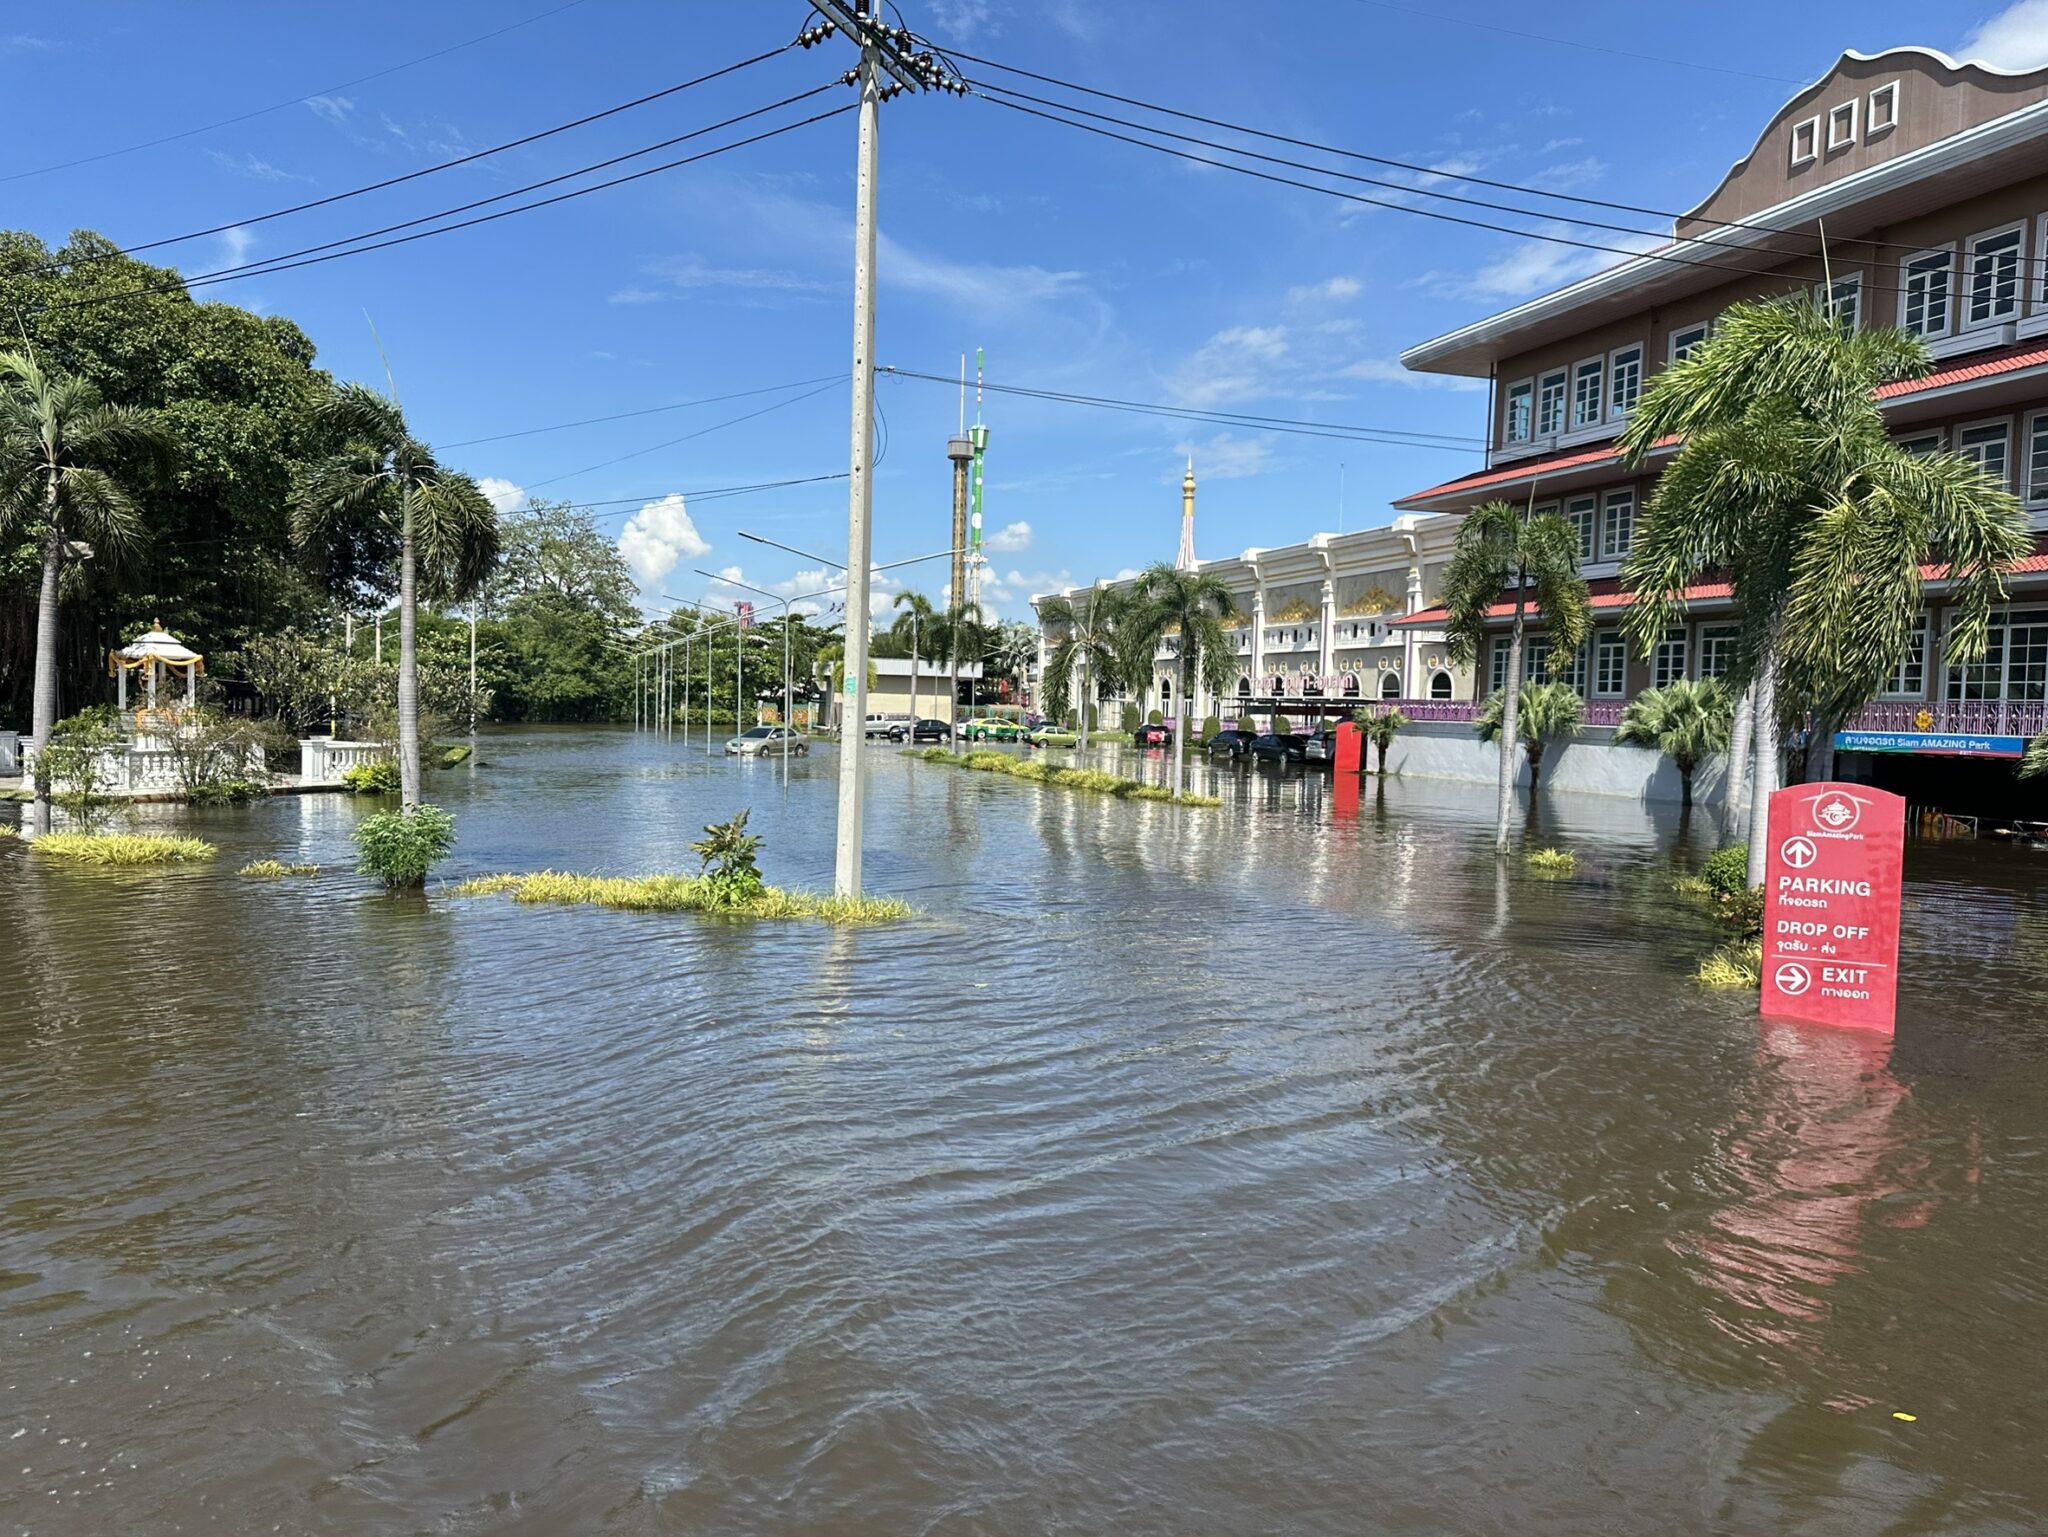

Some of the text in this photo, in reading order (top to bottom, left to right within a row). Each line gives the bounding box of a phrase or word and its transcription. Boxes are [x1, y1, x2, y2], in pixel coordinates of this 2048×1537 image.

[1897, 738, 1919, 747] Siam
[1920, 738, 1967, 749] AMAZING
[1968, 740, 1991, 750] Park
[1805, 830, 1865, 841] SiamAmazingPark
[1778, 876, 1871, 897] PARKING
[1778, 892, 1828, 909] ที่จอดรถ
[1777, 920, 1870, 940] DROP OFF
[1776, 939, 1809, 953] จุดรับ
[1821, 942, 1837, 955] ส่ง
[1822, 967, 1868, 984] EXIT
[1821, 987, 1870, 1000] ทางออก
